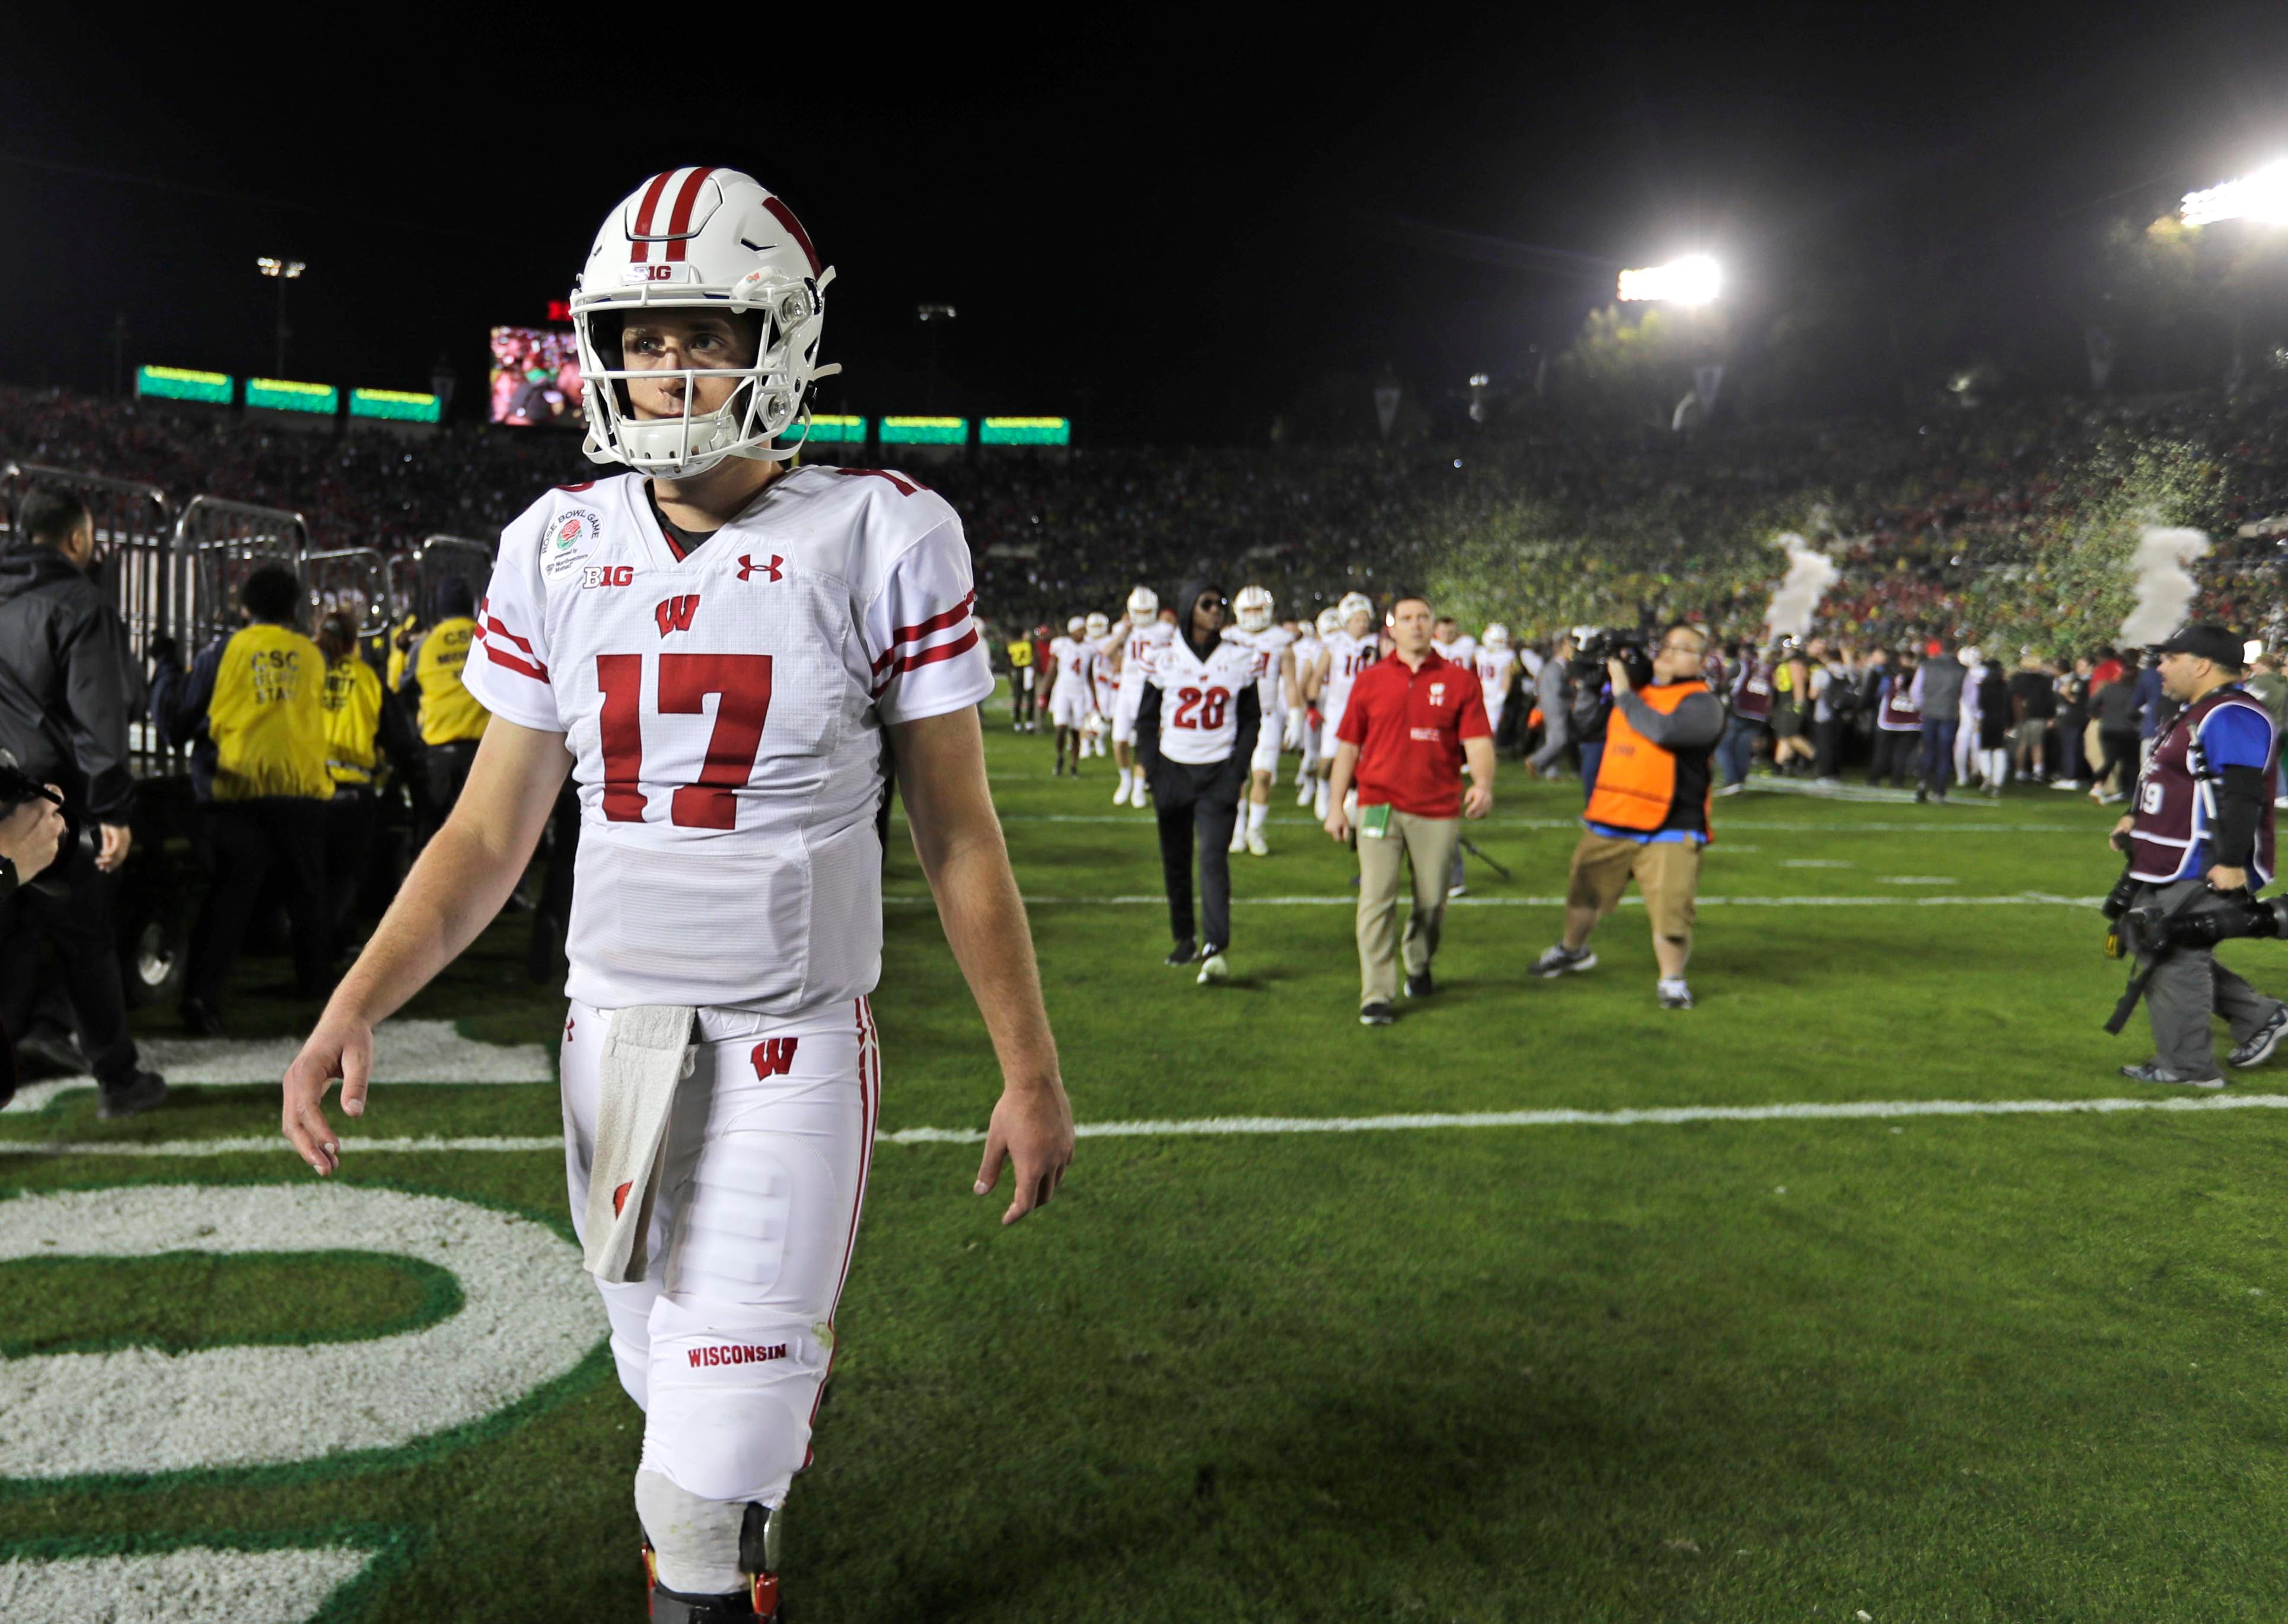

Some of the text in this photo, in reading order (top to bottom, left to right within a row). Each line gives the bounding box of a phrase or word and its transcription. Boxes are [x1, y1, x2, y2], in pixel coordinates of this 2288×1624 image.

[542, 509, 600, 554] ROSE BOWL GAME
[655, 594, 700, 640] W
[444, 628, 474, 645] CS
[251, 650, 299, 671] CSC
[1072, 657, 1081, 675] 4
[596, 653, 773, 830] 17
[750, 1038, 798, 1083] W
[687, 1343, 787, 1368] WISCONSIN
